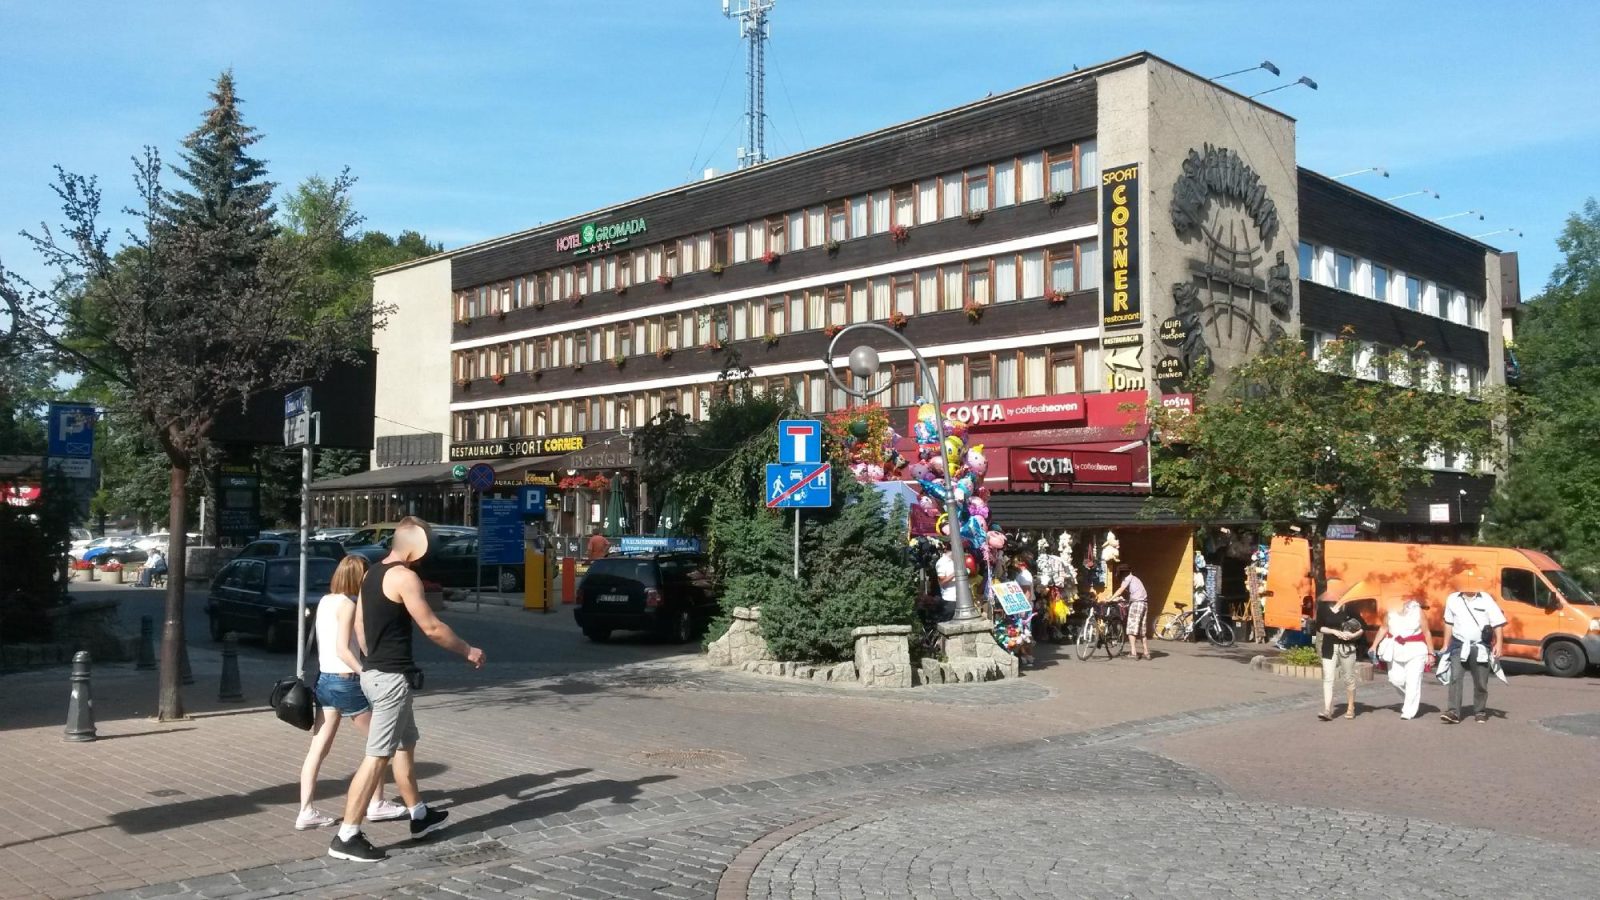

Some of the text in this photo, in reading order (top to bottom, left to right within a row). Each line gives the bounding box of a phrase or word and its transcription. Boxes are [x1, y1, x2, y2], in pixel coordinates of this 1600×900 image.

[1102, 167, 1138, 185] SPORT
[556, 218, 647, 252] HOTEL GROMADA
[1111, 184, 1130, 312] CORNER
[1103, 312, 1141, 325] restaurant
[1161, 359, 1179, 368] BAR
[1106, 373, 1144, 390] 10m
[1158, 371, 1183, 379] DINNER
[1163, 396, 1190, 408] COSTA
[946, 402, 1078, 425] COSTA by coffeeheaven
[451, 436, 584, 457] RESTAURACJA SPORT CORNER
[1028, 457, 1074, 476] COSTA
